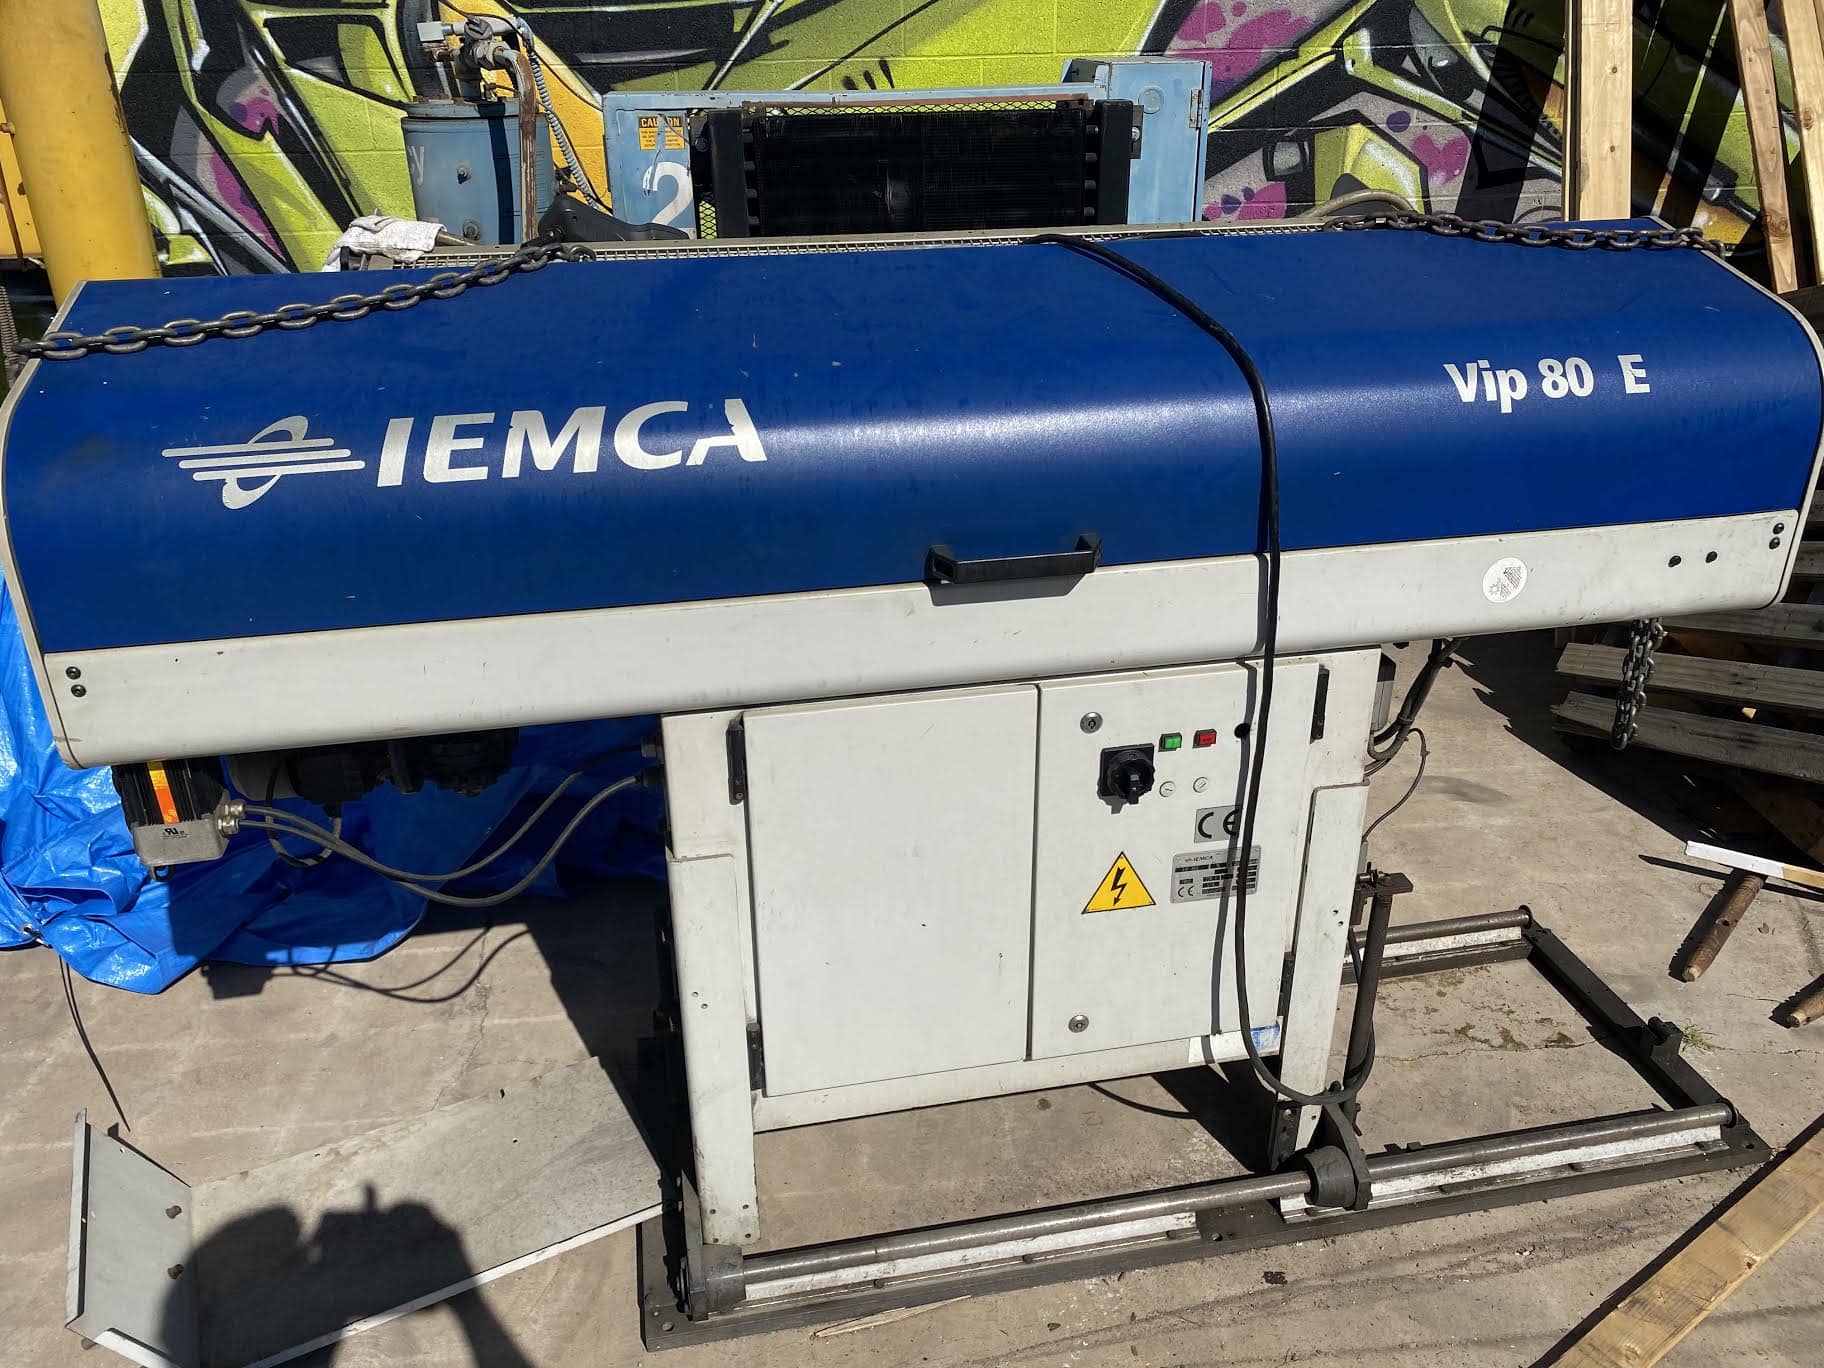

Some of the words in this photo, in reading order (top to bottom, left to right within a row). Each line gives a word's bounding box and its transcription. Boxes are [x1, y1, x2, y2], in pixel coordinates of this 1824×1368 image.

[641, 117, 680, 127] CAUON
[643, 162, 697, 240] 2
[1443, 359, 1528, 413] Vip
[1538, 357, 1594, 398] 80
[1617, 354, 1651, 394] E
[377, 398, 768, 487] IEMCA
